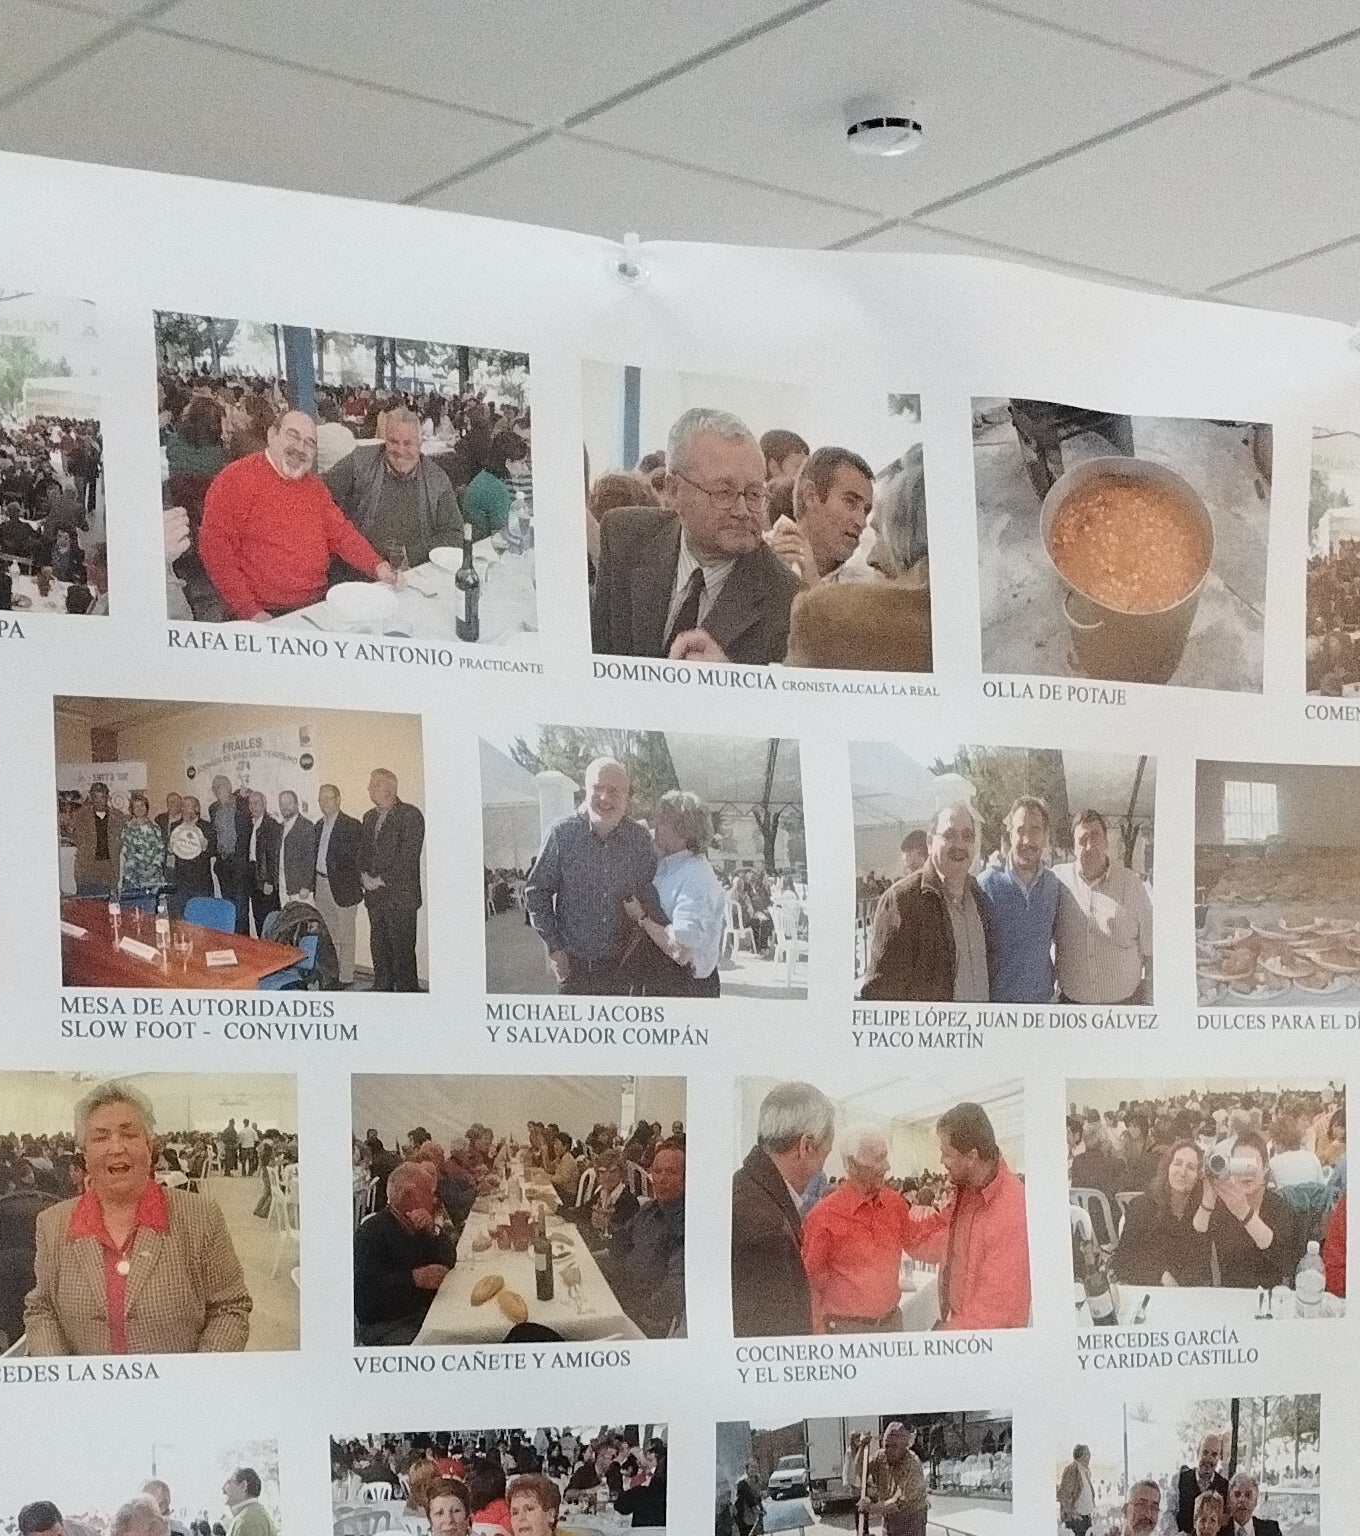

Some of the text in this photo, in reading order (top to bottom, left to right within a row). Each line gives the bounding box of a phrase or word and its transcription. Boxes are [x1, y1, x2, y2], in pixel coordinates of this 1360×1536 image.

[167, 630, 544, 674] RAFA EL TANO Y ANTONIO PRACTICANTE
[593, 662, 690, 684] DOMINGO
[698, 669, 776, 690] MURCIA
[782, 680, 840, 693] CRONISTA
[983, 681, 1126, 706] OLLA DE POTAJE
[61, 997, 335, 1017] MESA DE AUTORIDADES
[486, 1004, 665, 1023] MICHAEL JACOBS
[61, 1020, 358, 1041] SLOW FOOT CONVIVIUM
[1197, 1015, 1266, 1029] DULCES
[1271, 1015, 1315, 1029] PARA
[1320, 1015, 1340, 1029] EL
[487, 1024, 709, 1045] Y SALVADOR COMPÁN
[1078, 1325, 1239, 1350] MERCEDES GARCÍA
[354, 1351, 630, 1373] VECINO CAÑETE Y AMIGOS
[1078, 1348, 1259, 1370] Y CARIDAD CASTILLO
[67, 1364, 96, 1382] LA
[103, 1362, 159, 1380] SASA
[738, 1364, 857, 1383] Y EL SERENO
